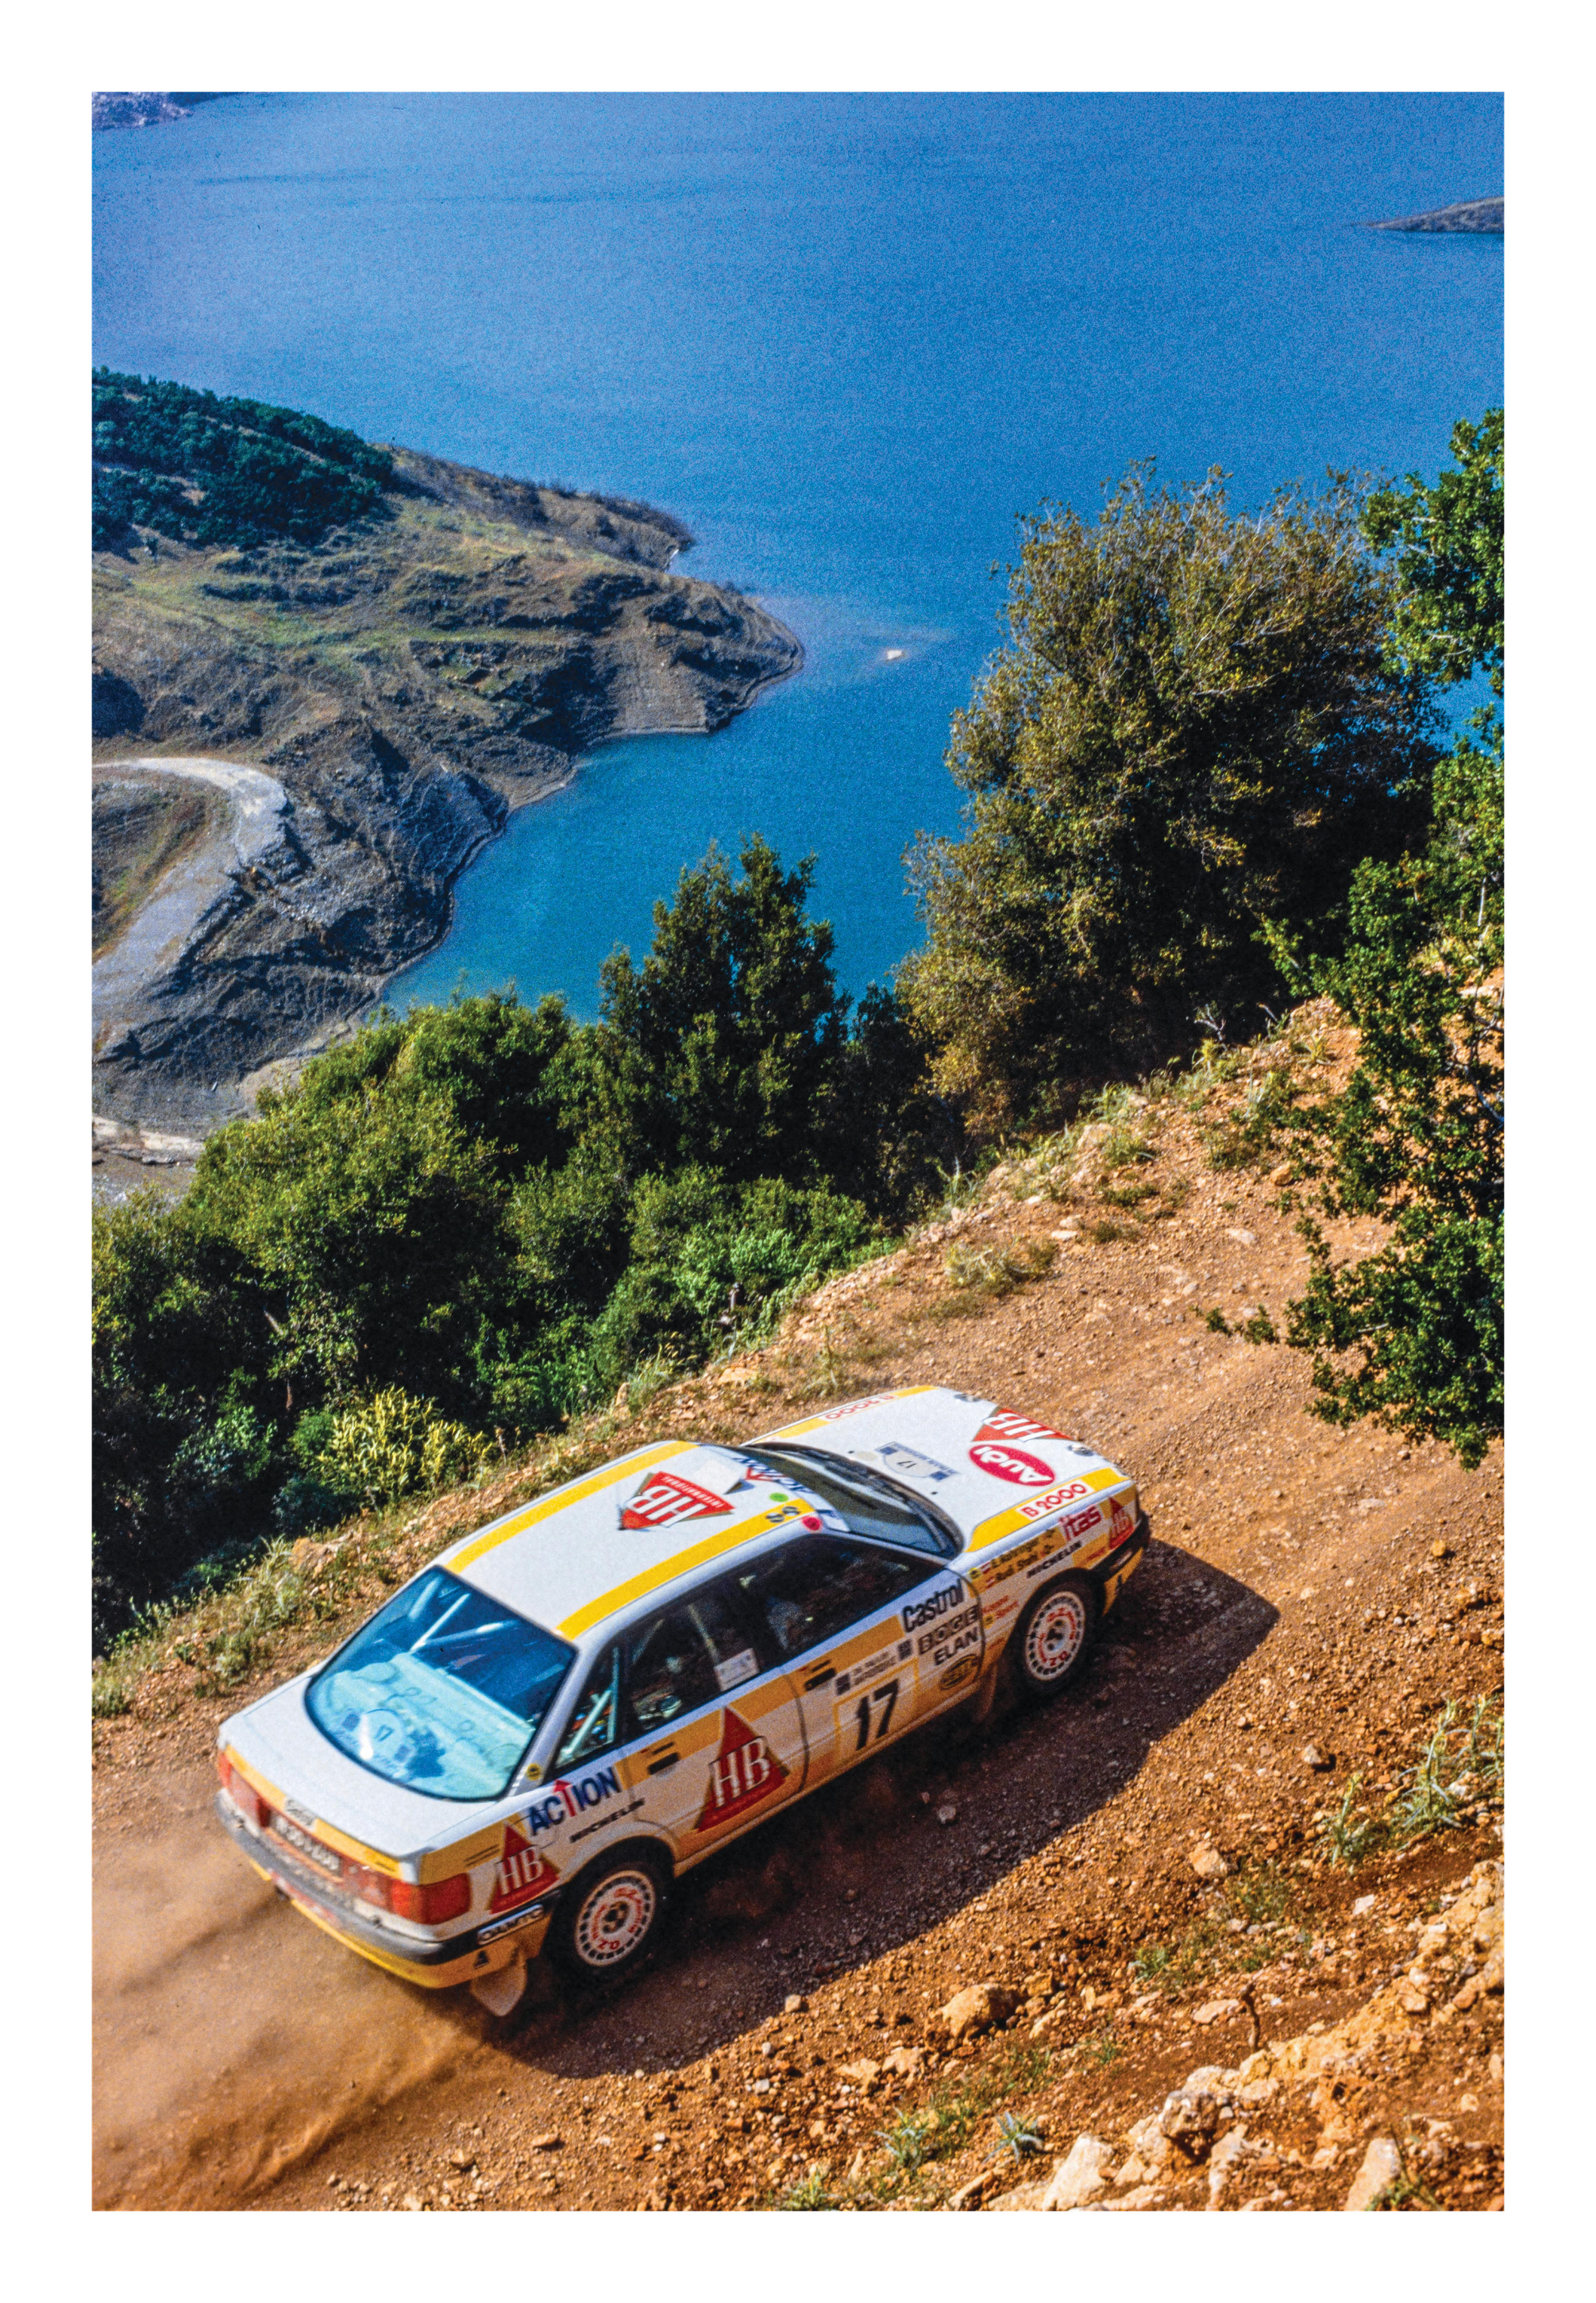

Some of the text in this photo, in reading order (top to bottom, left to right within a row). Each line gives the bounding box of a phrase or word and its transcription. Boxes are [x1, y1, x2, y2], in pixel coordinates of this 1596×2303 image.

[981, 1412, 1057, 1443] HB
[973, 1445, 1053, 1485] Audi
[625, 1484, 708, 1528] HB
[1021, 1483, 1087, 1518] B 2000
[1026, 1540, 1082, 1579] MICHELIN
[902, 1577, 965, 1634] Castrol
[917, 1605, 979, 1656] BOGE
[933, 1626, 979, 1665] ELAN
[855, 1678, 900, 1752] 17
[707, 1735, 771, 1811] HB
[527, 1765, 622, 1836] ACTION
[569, 1798, 645, 1844] MICHELIN
[495, 1845, 544, 1898] HB
